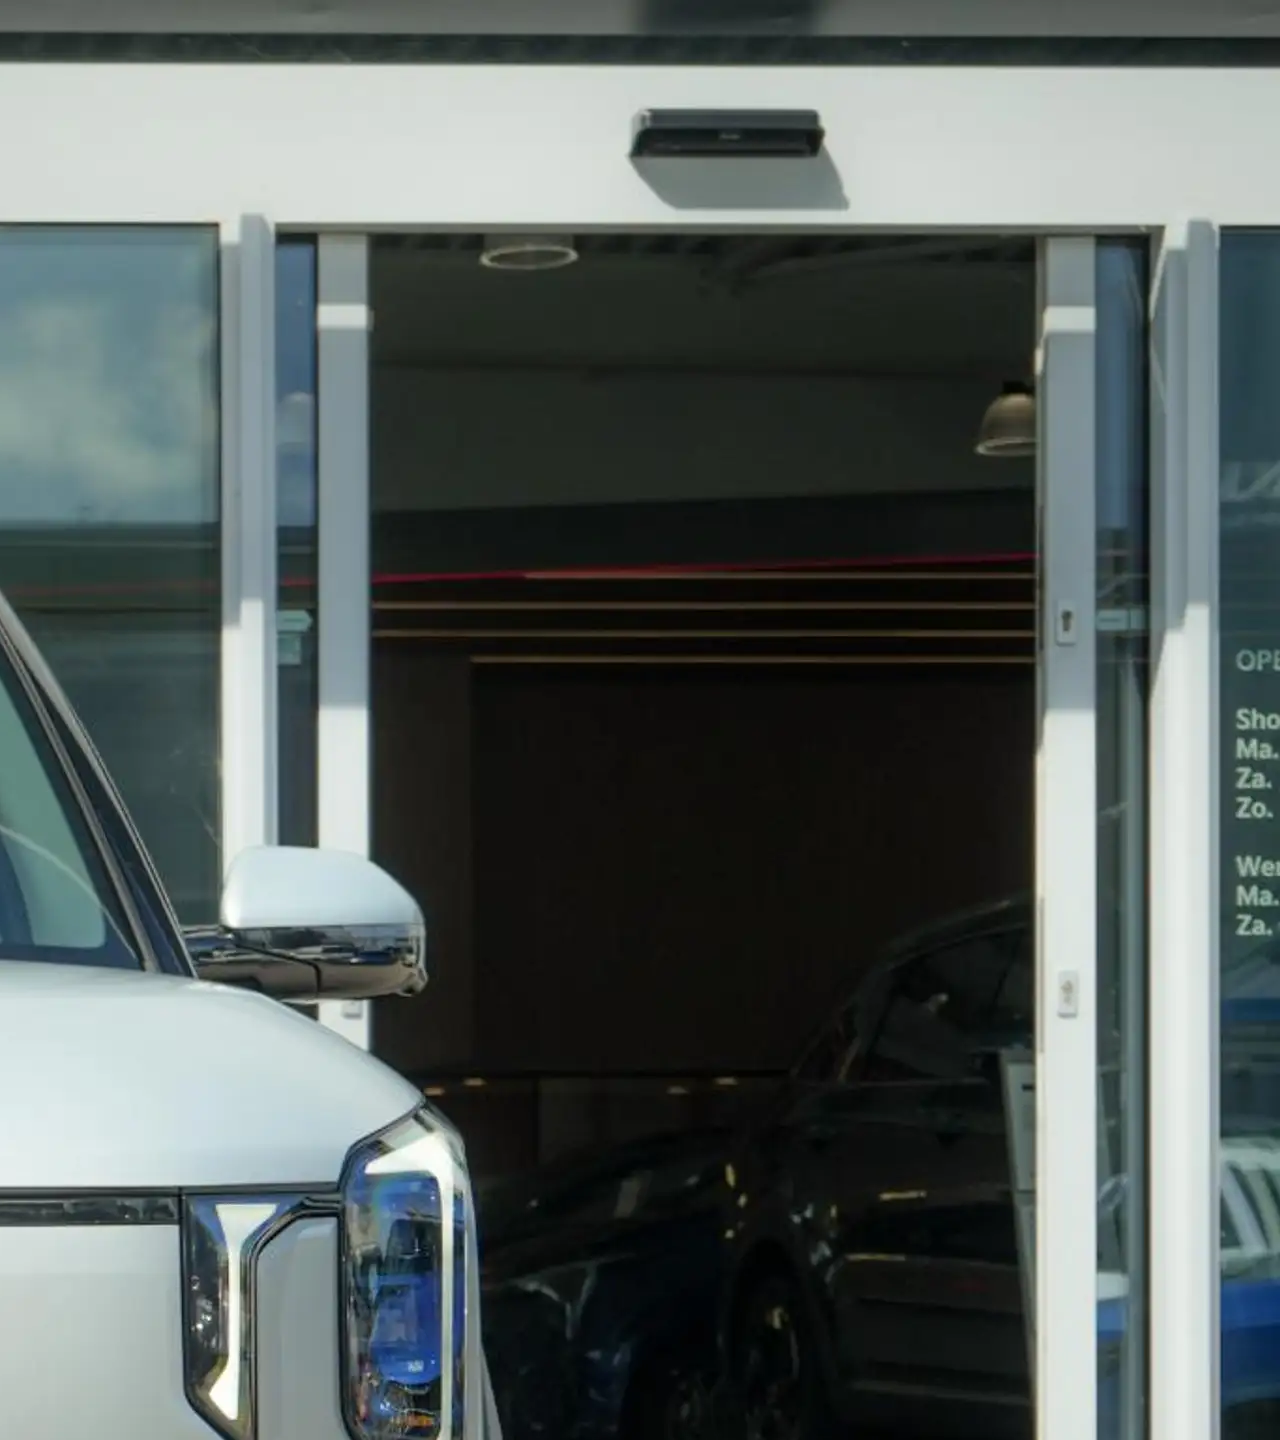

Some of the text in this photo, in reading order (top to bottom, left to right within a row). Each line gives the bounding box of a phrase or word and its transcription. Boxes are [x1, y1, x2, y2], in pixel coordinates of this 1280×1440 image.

[1236, 708, 1280, 730] Sho
[1236, 738, 1279, 760] Ma.
[1235, 766, 1272, 789] Za.
[1235, 796, 1274, 818] Zo.
[1236, 884, 1280, 906] Ma.
[1235, 913, 1273, 936] Za.
